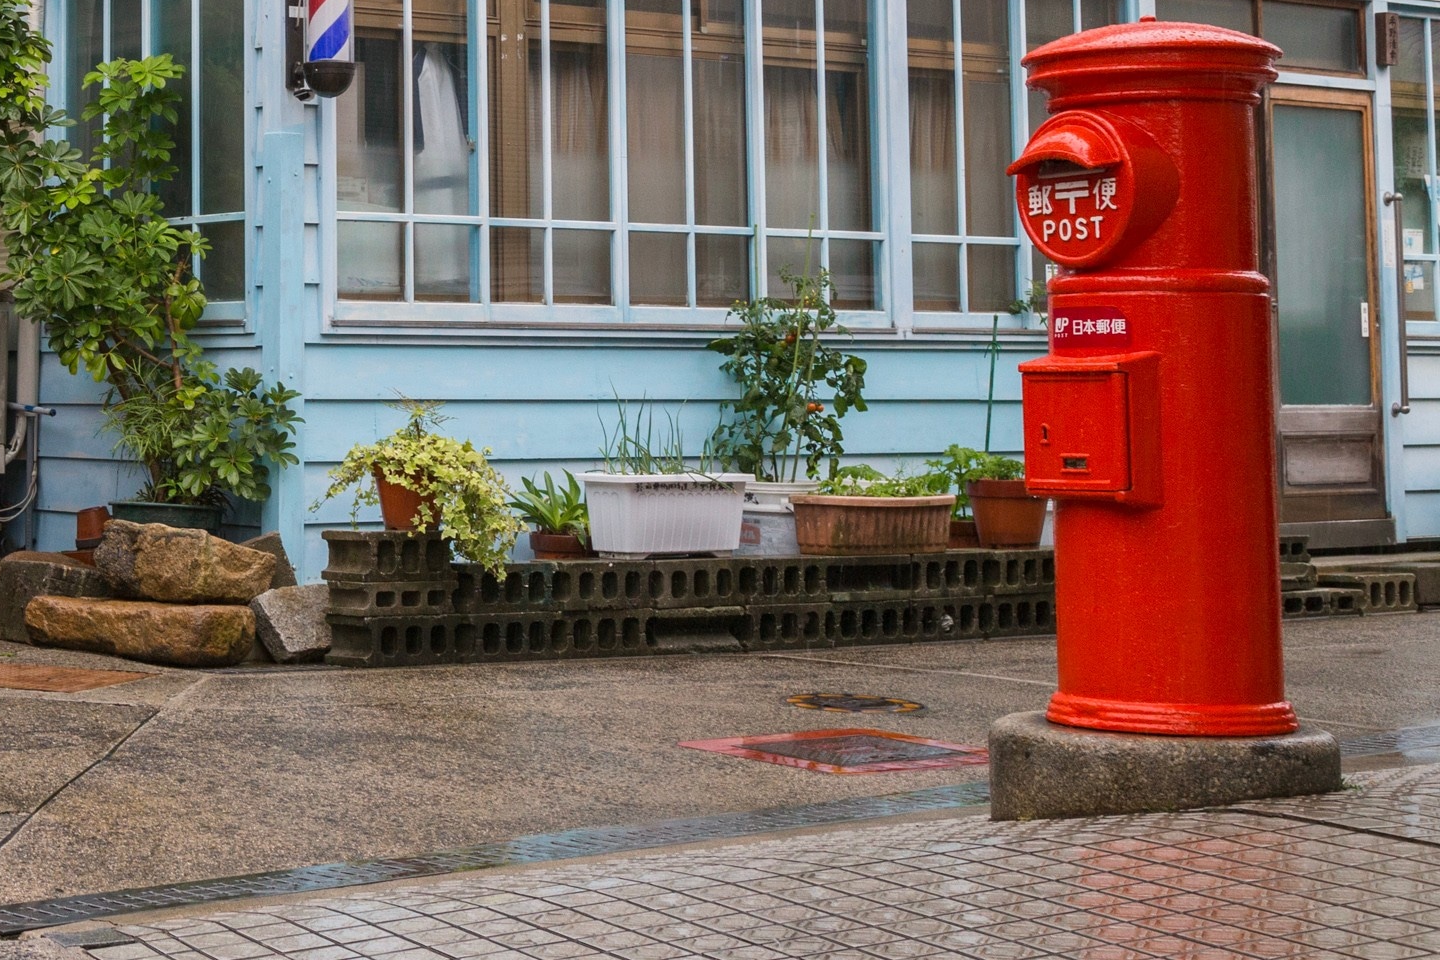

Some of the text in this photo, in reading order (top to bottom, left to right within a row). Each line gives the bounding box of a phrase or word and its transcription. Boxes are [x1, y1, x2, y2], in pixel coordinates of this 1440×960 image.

[1042, 216, 1104, 243] POST
[1072, 319, 1126, 335] 日本郵便
